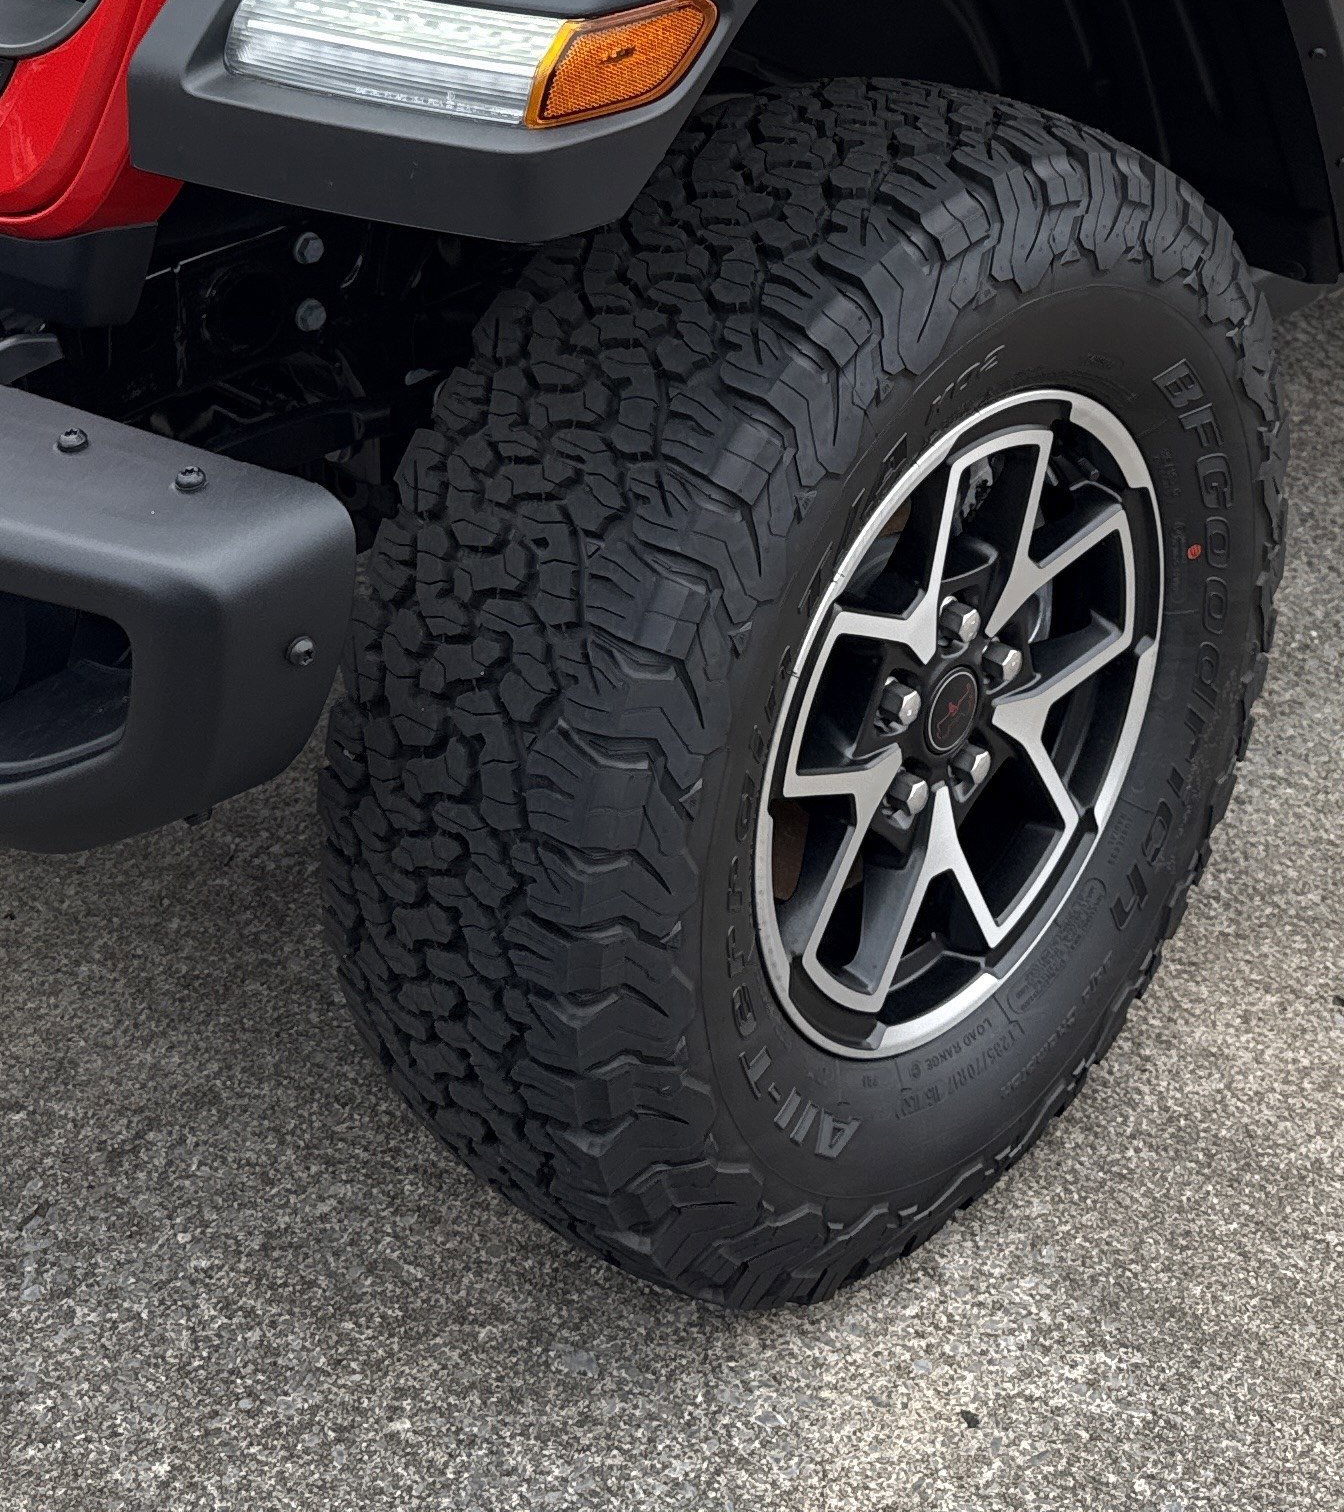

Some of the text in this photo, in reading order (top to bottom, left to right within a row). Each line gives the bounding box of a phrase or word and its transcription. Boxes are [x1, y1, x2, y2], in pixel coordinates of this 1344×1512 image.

[1111, 357, 1234, 931] BFGoodrich
[963, 1017, 993, 1048] LOAD
[924, 1044, 962, 1072] RANGE
